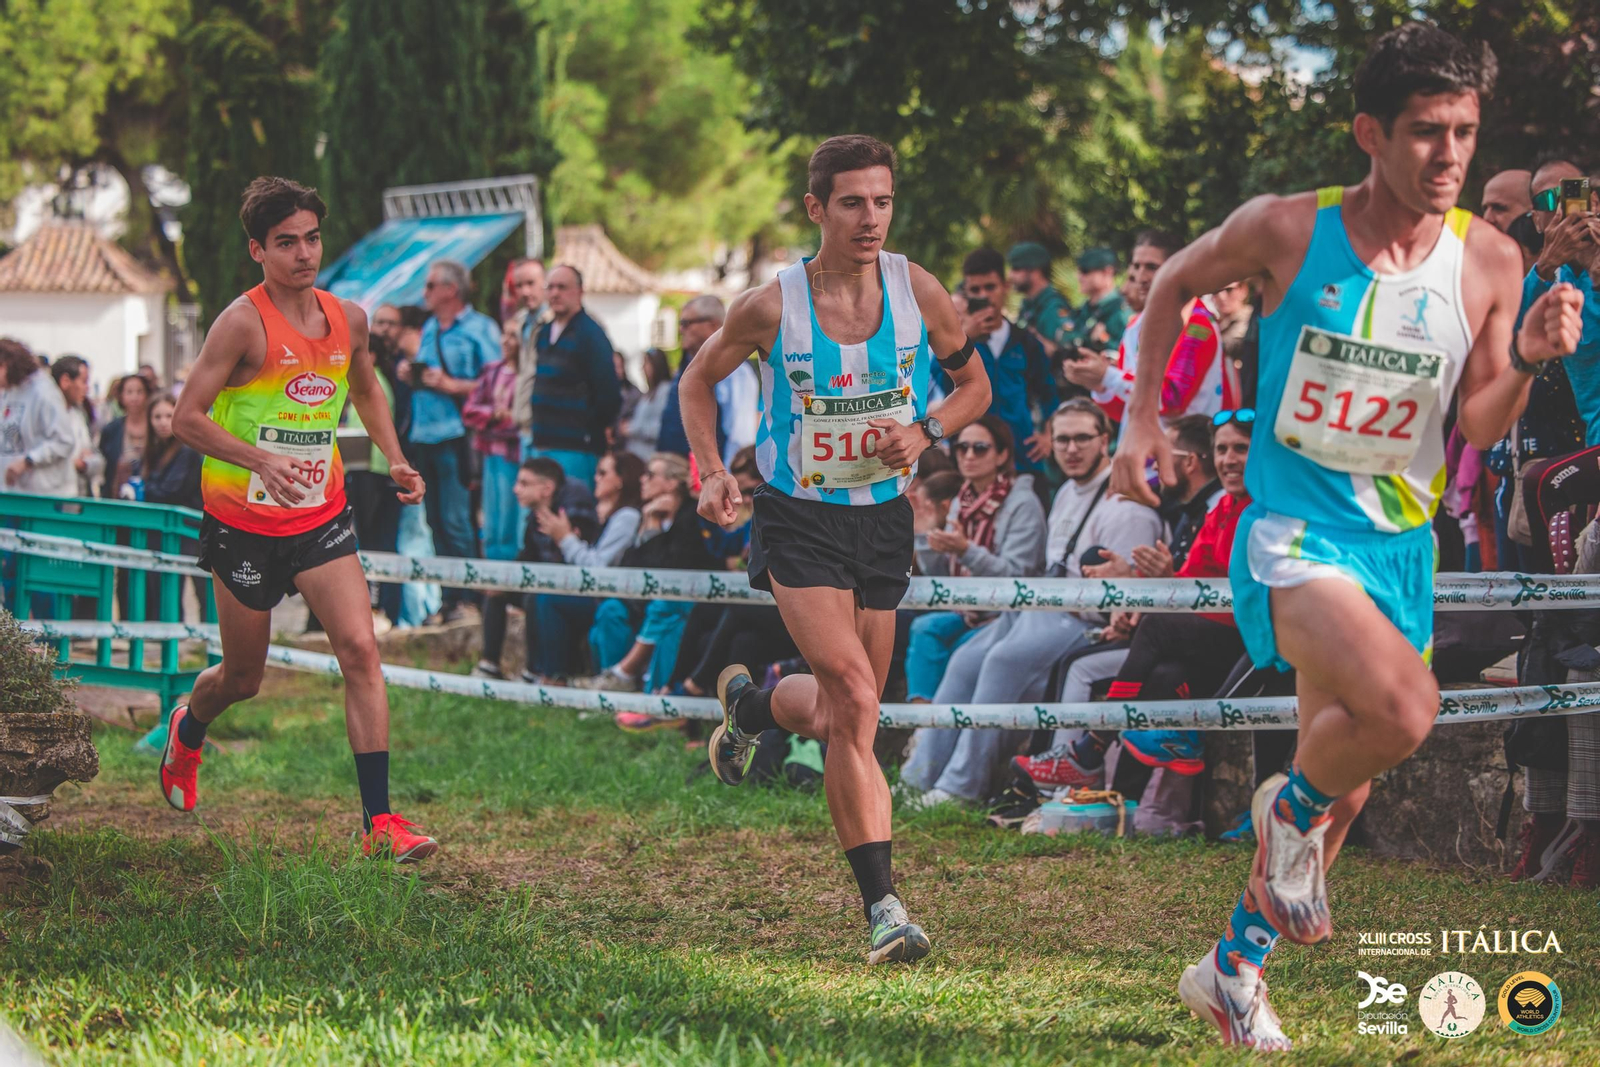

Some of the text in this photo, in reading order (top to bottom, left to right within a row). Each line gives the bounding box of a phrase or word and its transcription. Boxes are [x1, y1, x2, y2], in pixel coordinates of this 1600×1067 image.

[785, 352, 812, 362] vive
[1339, 343, 1408, 372] ITÁLICA
[834, 398, 884, 412] ITÁLICA
[1293, 380, 1418, 440] 5122
[283, 432, 318, 444] ITÁLICA
[813, 428, 881, 461] 510
[1551, 580, 1588, 588] Diputación
[1433, 592, 1467, 604] Sevilla
[1549, 589, 1587, 600] Sevilla
[1126, 596, 1154, 607] Sevilla
[1463, 701, 1498, 714] Sevilla
[1247, 714, 1281, 725] Sevilla
